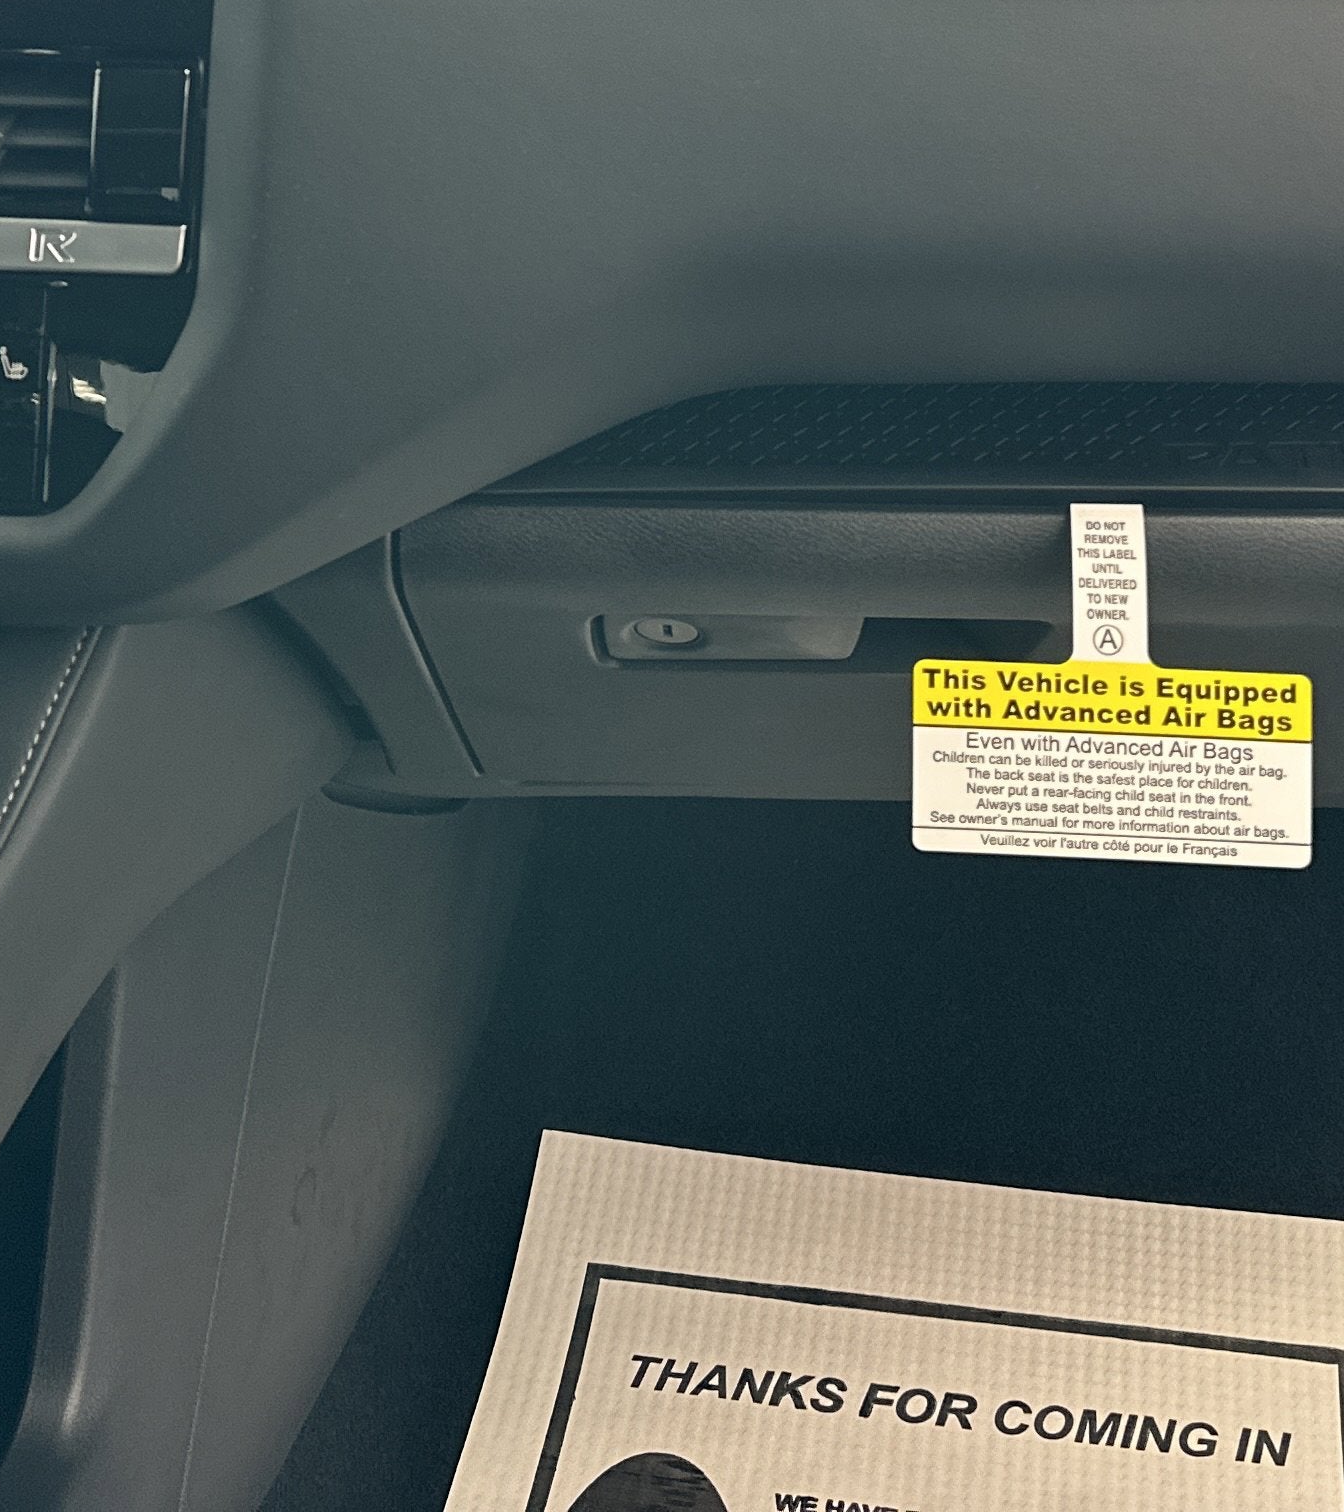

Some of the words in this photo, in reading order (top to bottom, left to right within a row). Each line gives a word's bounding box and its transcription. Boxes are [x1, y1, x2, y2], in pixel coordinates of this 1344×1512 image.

[1086, 521, 1100, 530] DO
[1104, 522, 1125, 531] NOT
[1085, 535, 1128, 545] REMOVE
[1077, 548, 1099, 558] THIS
[1103, 549, 1136, 559] LABEL
[1092, 564, 1122, 574] UNTIL
[1079, 578, 1137, 589] DELIVERED
[1087, 593, 1101, 604] TO
[1105, 594, 1128, 604] NEW
[1087, 609, 1129, 620] OWNER.
[923, 668, 986, 690] This
[997, 671, 1108, 695] Vehicle
[1120, 676, 1144, 697] is
[1157, 678, 1296, 706] Equipped
[927, 697, 991, 718] with
[1003, 700, 1150, 725] Advanced
[1162, 706, 1206, 727] Air
[1217, 709, 1292, 736] Bags
[967, 732, 1014, 750] Even
[1021, 735, 1059, 752] with
[1066, 736, 1163, 757] Advanced
[1169, 741, 1196, 758] Air
[1204, 743, 1253, 764] Bags
[933, 751, 984, 764] Children
[989, 755, 1011, 765] can
[1016, 754, 1031, 766] be
[1035, 755, 1067, 767] killed
[1072, 758, 1085, 768] or
[1088, 758, 1144, 773] seriously
[1149, 761, 1191, 773] injured
[1196, 762, 1211, 776] by
[1215, 764, 1235, 775] the
[1239, 766, 1255, 776] air
[1259, 765, 1287, 780] bag.
[966, 767, 990, 779] The
[995, 768, 1024, 781] back
[1029, 771, 1055, 782] seat
[1059, 771, 1068, 782] is
[1073, 773, 1092, 784] the
[1097, 773, 1135, 785] safest
[1140, 775, 1173, 789] place
[1178, 776, 1194, 788] for
[1198, 778, 1252, 791] children.
[966, 783, 1004, 794] Never
[1008, 785, 1027, 798] put
[1031, 788, 1039, 796] a
[1043, 788, 1111, 802] rear-facing
[1115, 790, 1144, 802] child
[1149, 792, 1176, 803] seat
[1180, 792, 1191, 803] in
[1195, 792, 1215, 804] the
[1220, 793, 1252, 806] front.
[976, 799, 1021, 813] Always
[1026, 803, 1048, 812] use
[1052, 803, 1079, 813] seat
[1083, 803, 1113, 814] belts
[1117, 804, 1140, 817] and
[1145, 806, 1174, 818] child
[1178, 808, 1241, 821] restraints.
[930, 811, 955, 823] See
[959, 814, 1007, 825] owner's
[1012, 816, 1058, 827] manual
[1062, 817, 1079, 828] for
[1083, 820, 1114, 829] more
[1119, 820, 1189, 834] information
[1194, 823, 1230, 835] about
[1234, 826, 1250, 836] air
[1254, 826, 1289, 840] bags.
[980, 834, 1029, 847] Veuillez
[1034, 837, 1056, 848] voir
[1061, 837, 1098, 849] l'autre
[1103, 838, 1129, 851] côté
[1134, 843, 1163, 854] pour
[1167, 842, 1178, 853] le
[1183, 843, 1238, 858] Français
[630, 1354, 847, 1413] THANKS
[858, 1383, 978, 1430] FOR
[994, 1400, 1219, 1457] COMING
[1235, 1427, 1292, 1467] IN
[775, 1493, 818, 1512] WE
